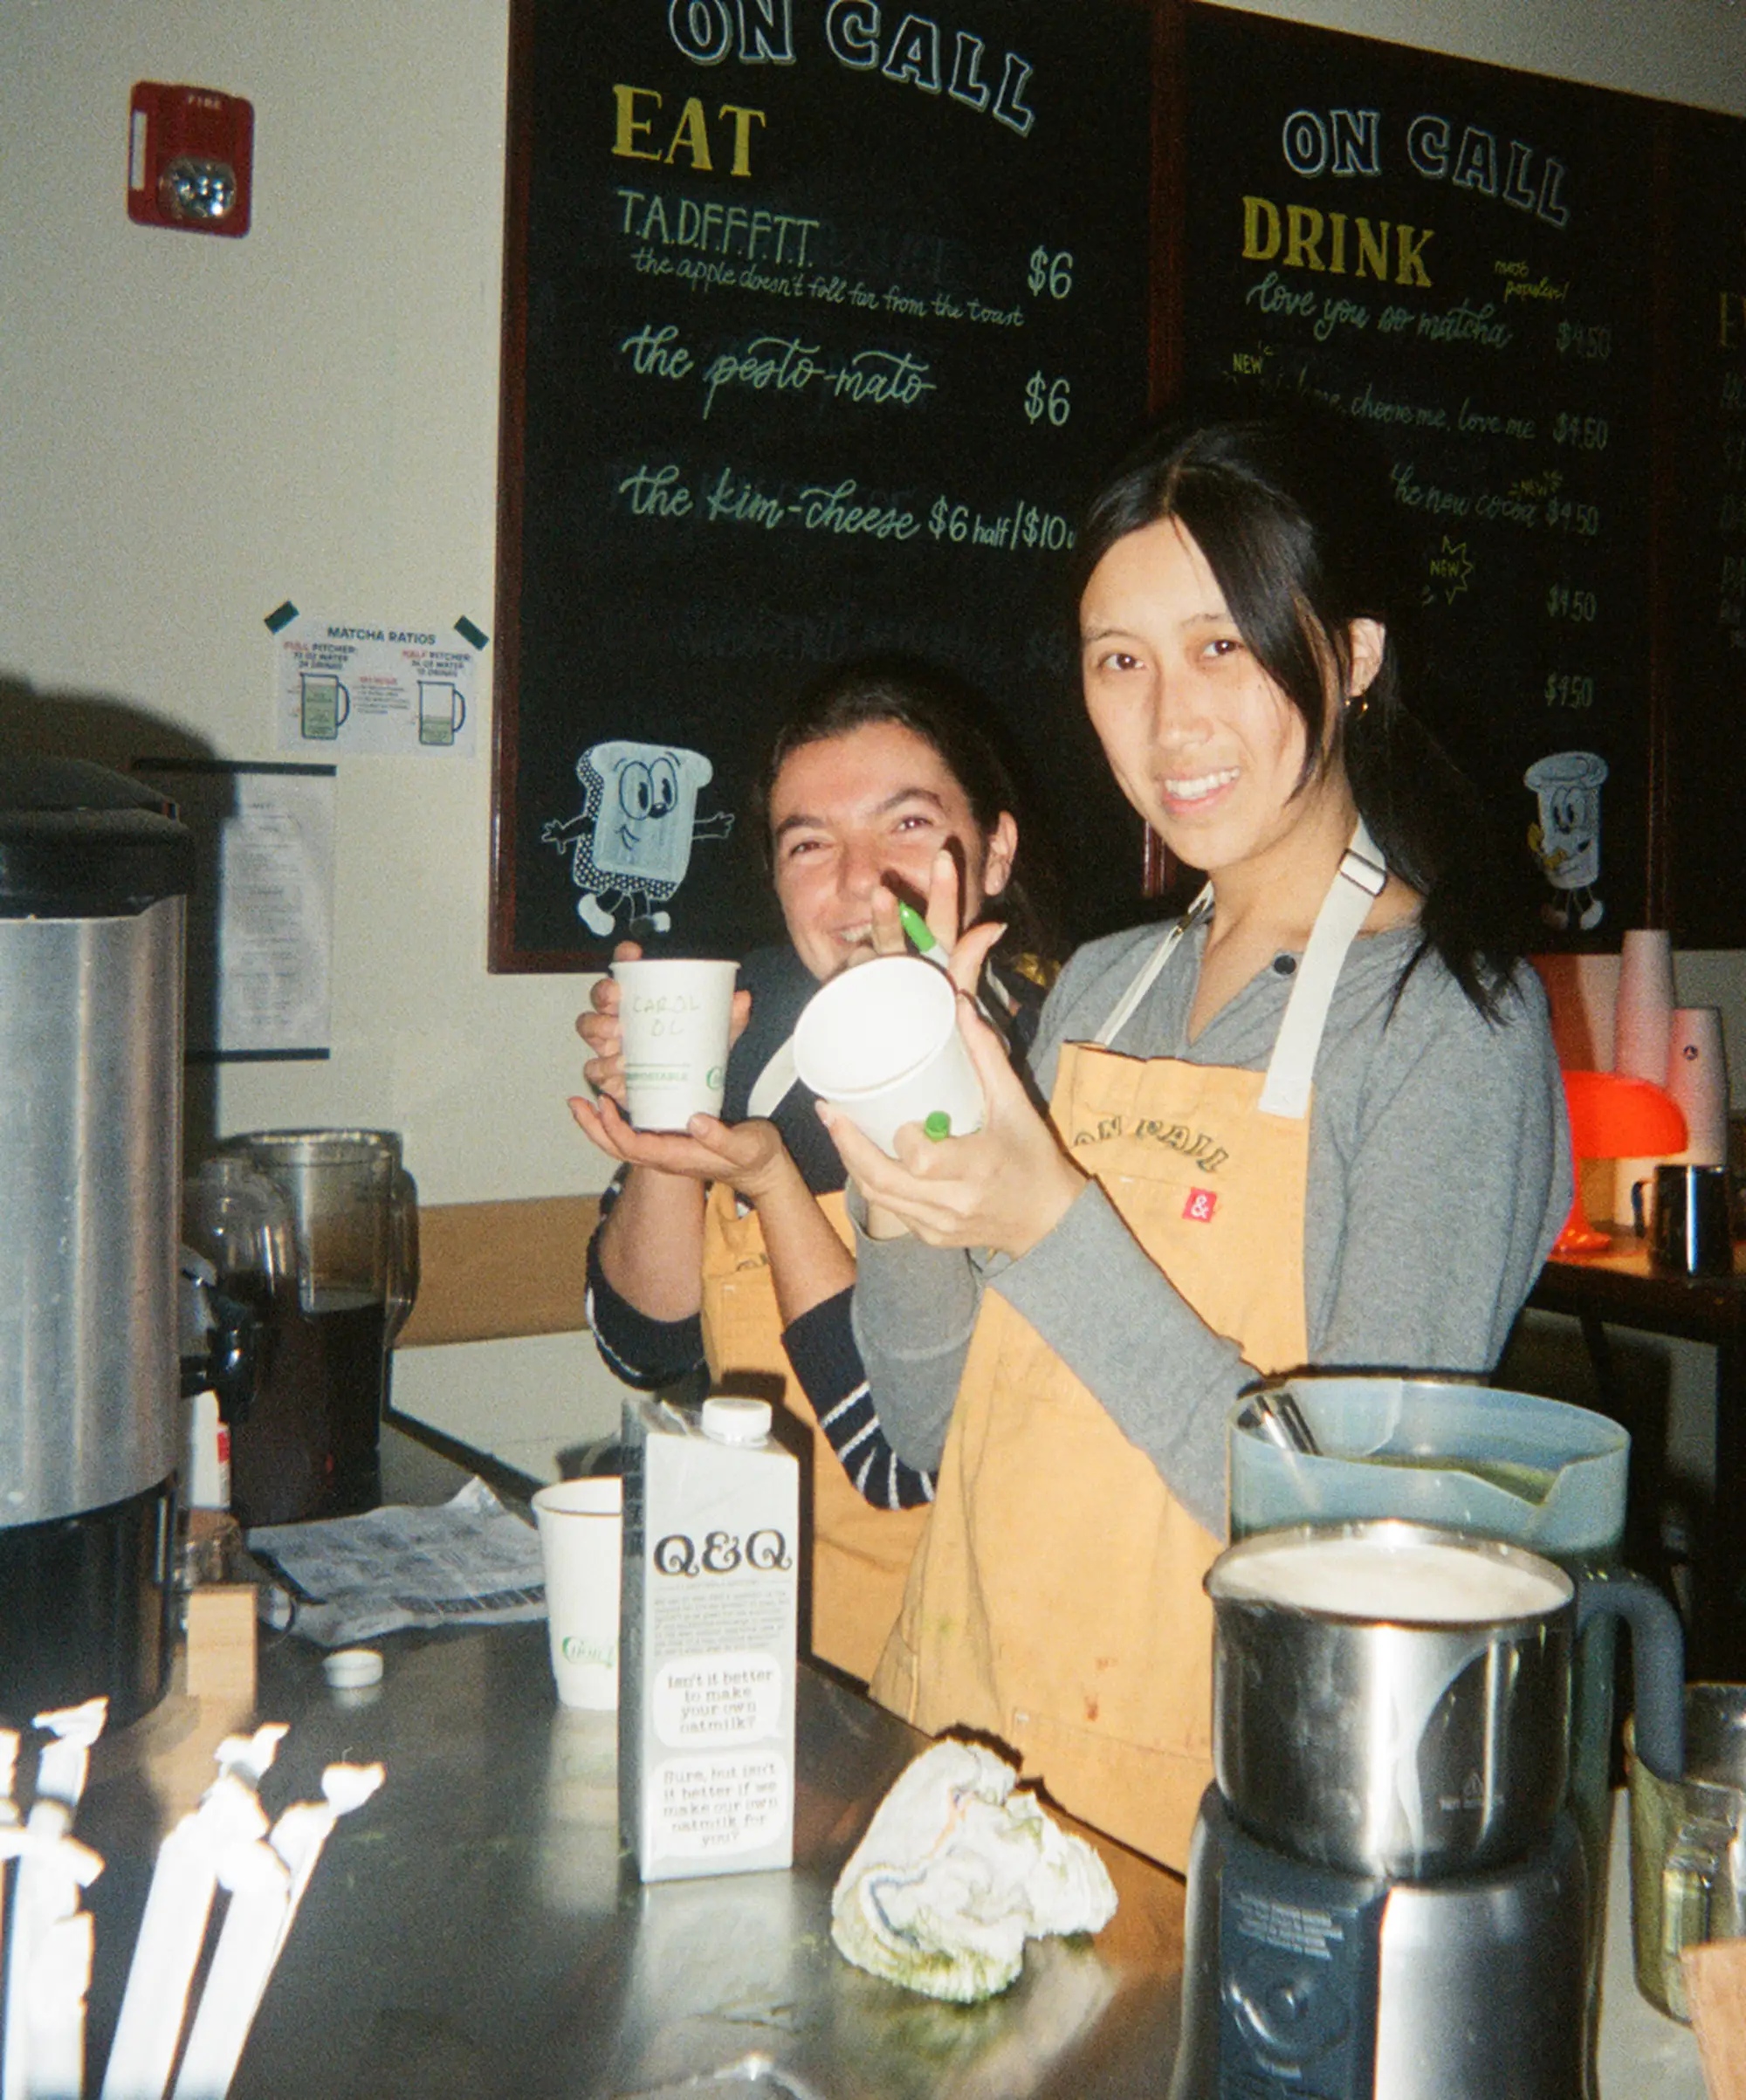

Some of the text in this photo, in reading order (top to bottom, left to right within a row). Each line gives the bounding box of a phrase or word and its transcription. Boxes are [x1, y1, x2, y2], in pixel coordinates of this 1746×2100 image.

[669, 0, 1035, 137] ON CALL
[611, 84, 766, 176] EAT
[1282, 108, 1571, 229] ON CALL
[1241, 195, 1435, 288] DRINK
[630, 247, 673, 274] the
[676, 257, 736, 292] apple
[739, 264, 804, 296] doesn't
[849, 287, 880, 312] far
[883, 284, 927, 318] from
[931, 293, 964, 320] the
[968, 298, 1026, 326] toast
[1027, 244, 1074, 299] $6
[1313, 296, 1372, 342] you
[1416, 298, 1514, 348] matcha
[621, 324, 694, 381] the
[1232, 352, 1264, 374] NEW
[1024, 370, 1072, 427] $6
[1457, 396, 1499, 432] love
[1505, 415, 1536, 439] me
[1552, 411, 1609, 450] $4.50
[619, 464, 695, 518] the
[928, 494, 969, 541] $6
[1429, 559, 1459, 578] NEW
[327, 627, 436, 645] MATCHA RATIOS
[633, 994, 700, 1013] CAROL
[1190, 1194, 1210, 1219] &
[654, 1529, 793, 1578] Q&Q
[684, 1686, 752, 1703] to make
[707, 1673, 719, 1685] it
[723, 1670, 773, 1685] better
[680, 1703, 757, 1719] your own
[680, 1716, 757, 1734] oatmilk?
[664, 1782, 777, 1801] it better if we
[711, 1766, 736, 1781] but
[663, 1798, 778, 1817] make our own
[672, 1815, 768, 1832] oatmilk for
